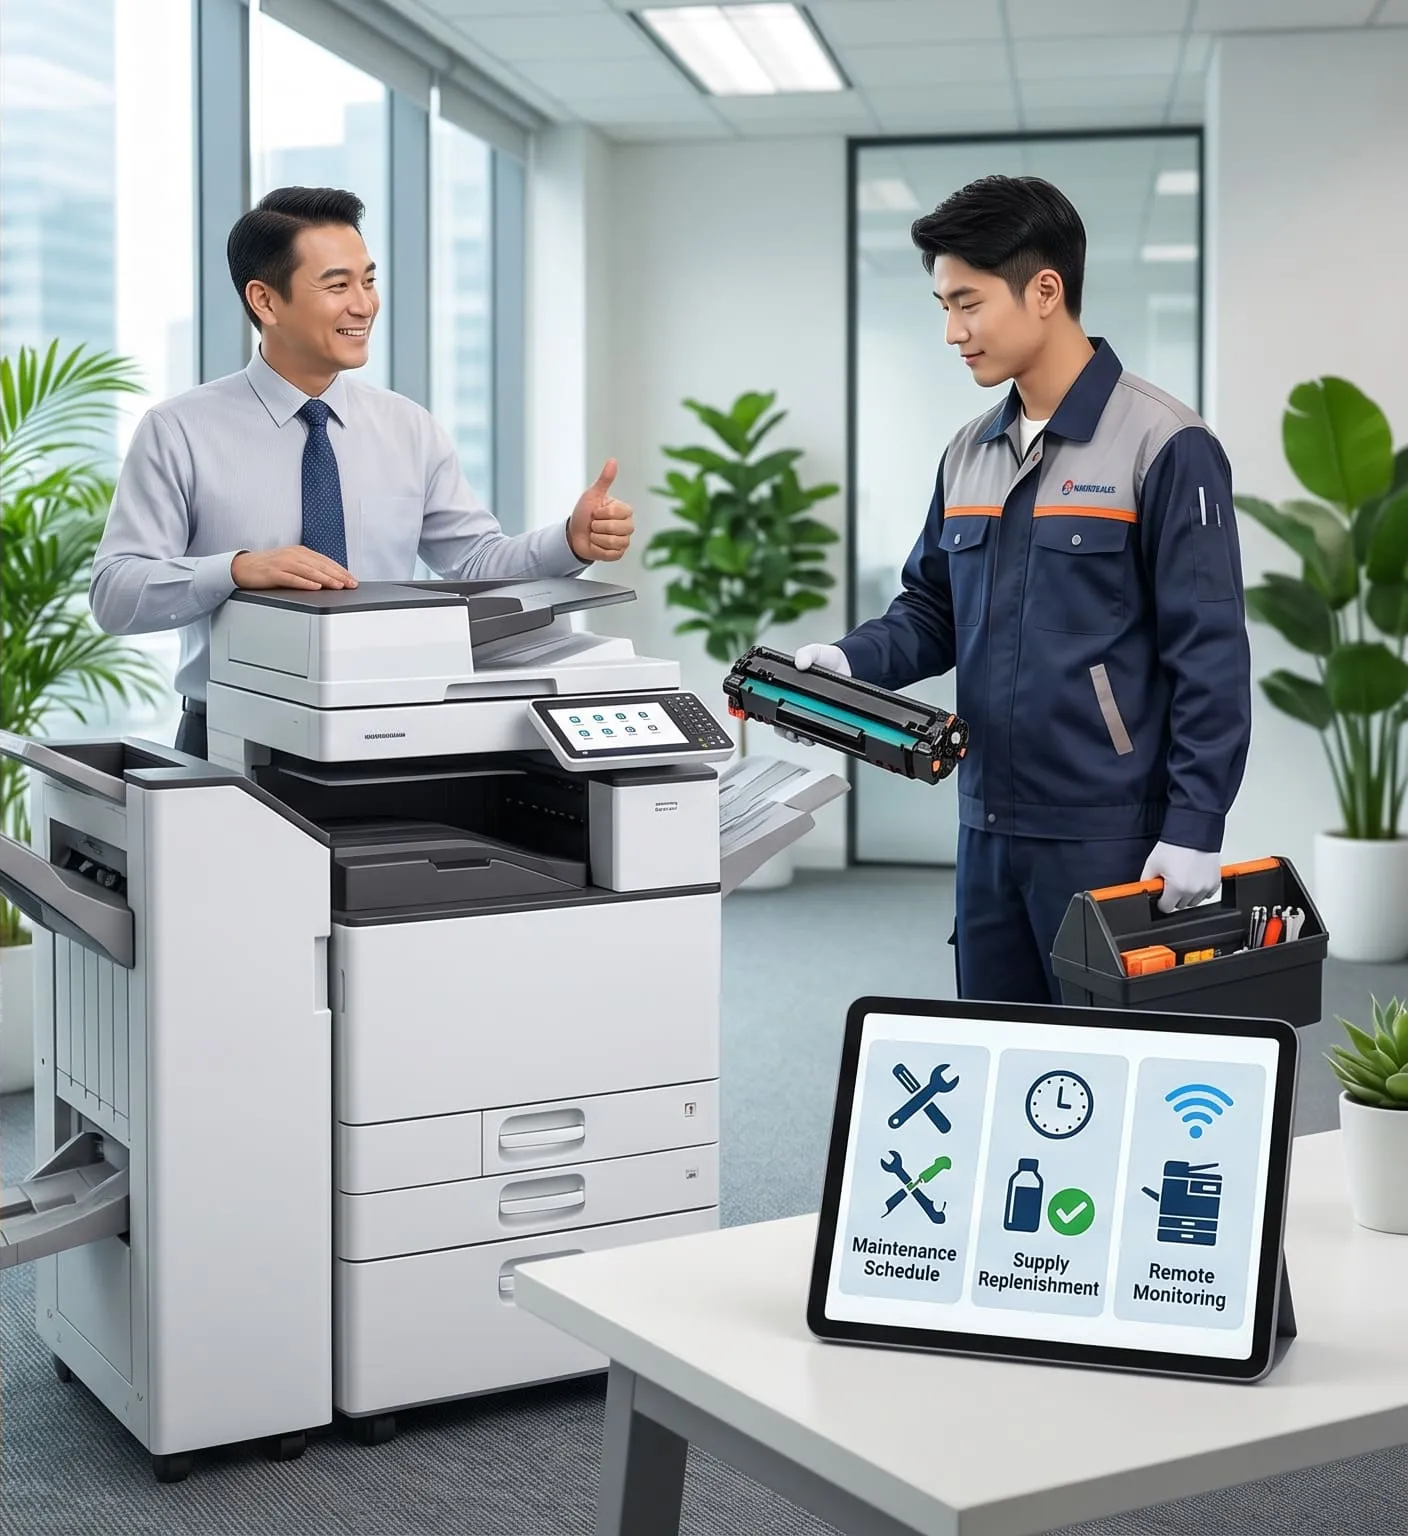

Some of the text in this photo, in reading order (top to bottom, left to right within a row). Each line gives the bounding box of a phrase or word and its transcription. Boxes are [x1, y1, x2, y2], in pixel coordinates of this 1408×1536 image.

[852, 1237, 957, 1262] Maintenance
[863, 1260, 940, 1282] Schedule
[1012, 1252, 1070, 1275] Supply
[1148, 1262, 1215, 1284] Remote
[978, 1270, 1100, 1297] Replenishment
[1133, 1283, 1226, 1311] Monitoring
